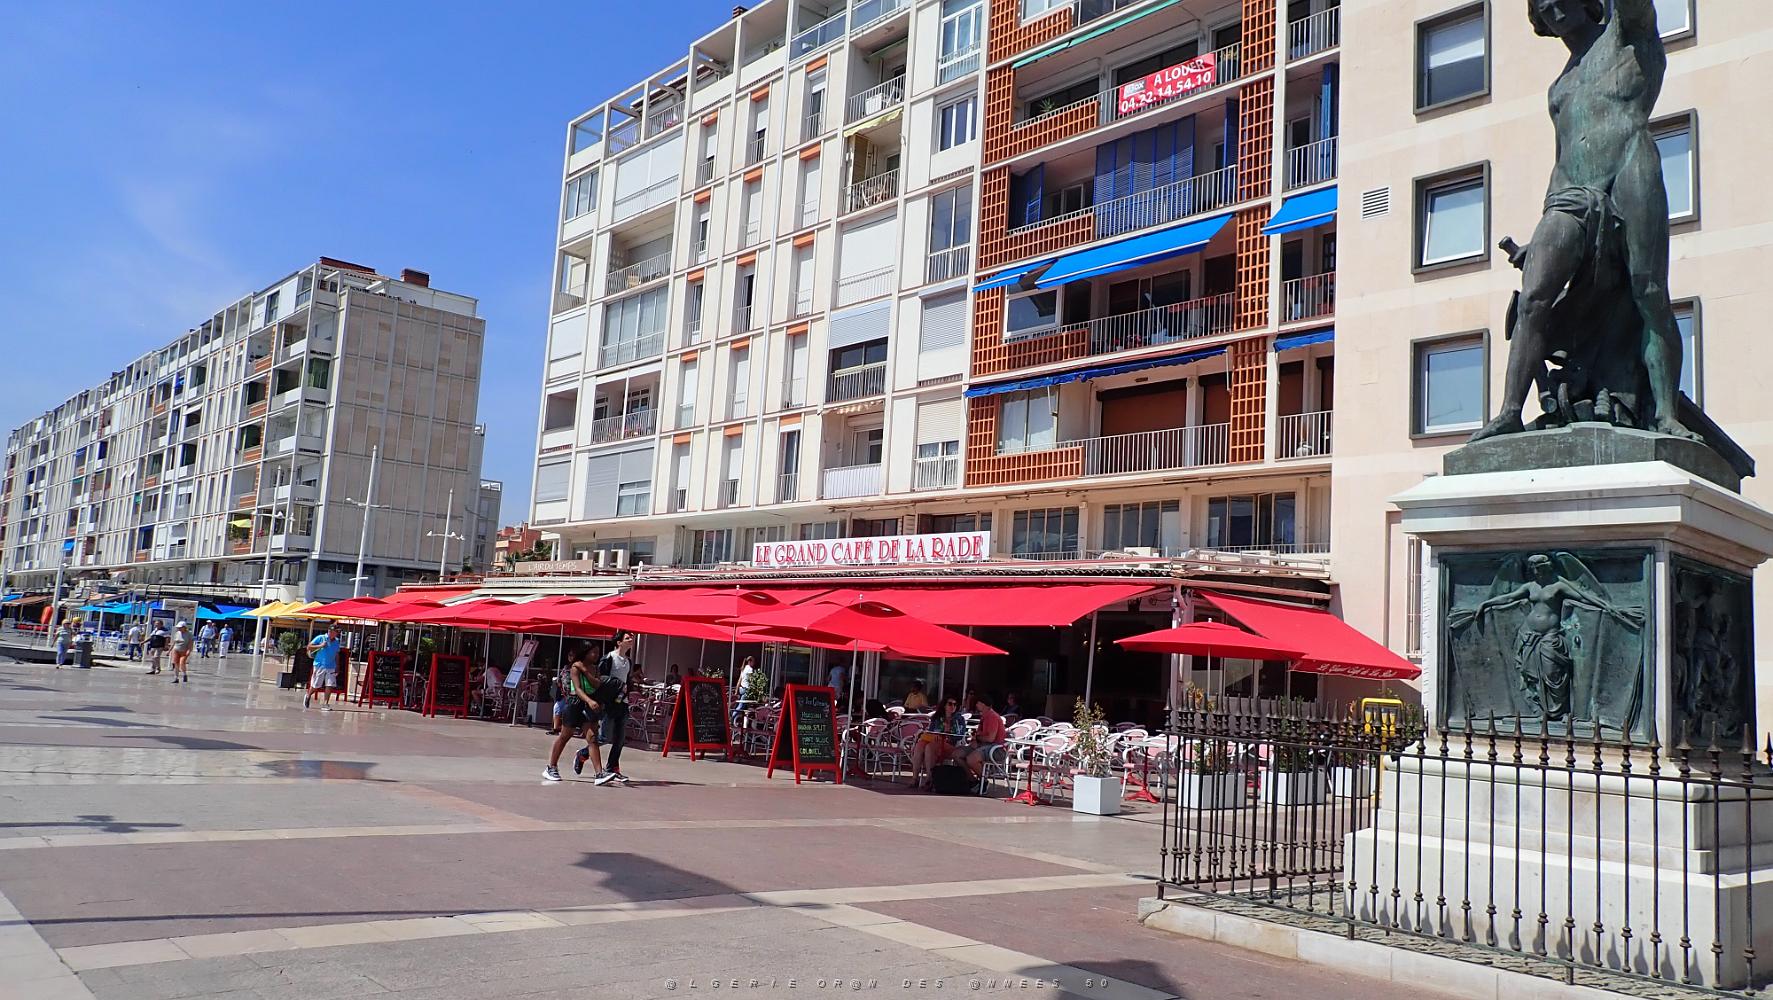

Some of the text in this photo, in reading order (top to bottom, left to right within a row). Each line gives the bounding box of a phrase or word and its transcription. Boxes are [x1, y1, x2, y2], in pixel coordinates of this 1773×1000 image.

[1153, 73, 1163, 87] A
[755, 534, 984, 563] LE GRAND CAFÉ DE LA RADE
